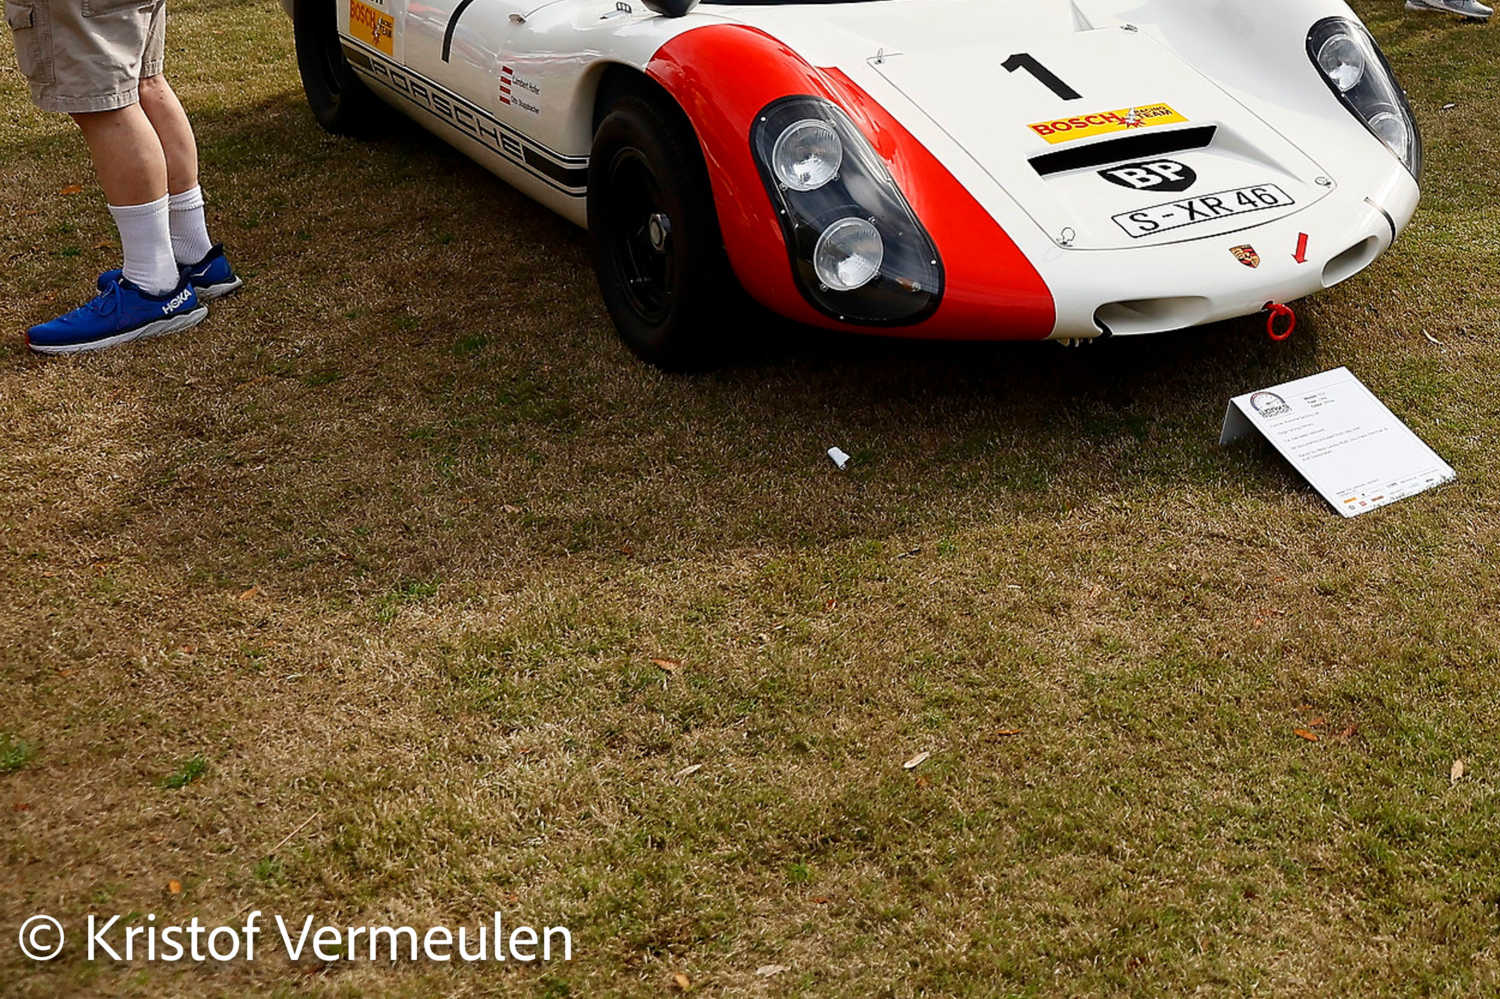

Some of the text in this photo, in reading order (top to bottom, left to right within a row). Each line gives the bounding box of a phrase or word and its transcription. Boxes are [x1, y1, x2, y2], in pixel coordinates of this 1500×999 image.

[350, 0, 376, 29] BOSCH
[1000, 52, 1084, 101] 1
[369, 56, 525, 162] PORSCHE
[1136, 108, 1173, 120] TEAM
[1031, 112, 1123, 136] BOSCH
[1107, 161, 1186, 188] BP
[1235, 187, 1279, 208] 46
[161, 289, 192, 314] HOKA
